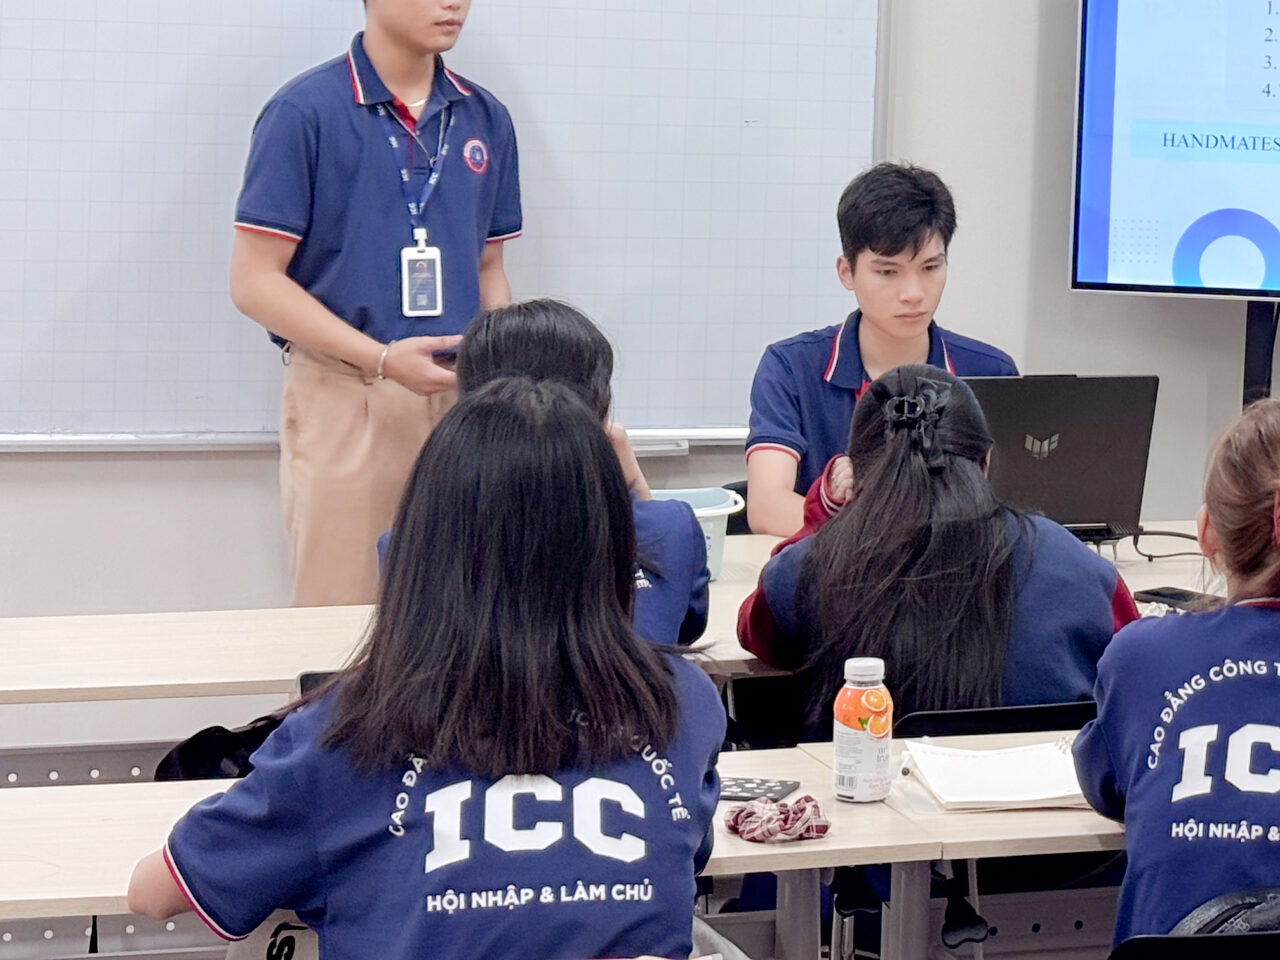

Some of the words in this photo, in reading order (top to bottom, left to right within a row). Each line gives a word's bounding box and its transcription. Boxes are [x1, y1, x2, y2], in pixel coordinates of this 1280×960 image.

[1146, 725, 1166, 770] CAO
[1160, 674, 1206, 725] ĐẲNG
[1208, 658, 1268, 682] CÔNG
[388, 791, 409, 837] CAO
[424, 773, 647, 874] ICC
[668, 791, 691, 821] TẾ
[1171, 819, 1203, 841] HỘI
[1208, 821, 1263, 843] NHẬP
[1268, 825, 1280, 840] &
[426, 889, 467, 914] HỘI
[471, 886, 535, 911] NHẬP
[538, 887, 556, 904] &
[560, 880, 606, 902] LÀM
[611, 877, 654, 902] CHỦ
